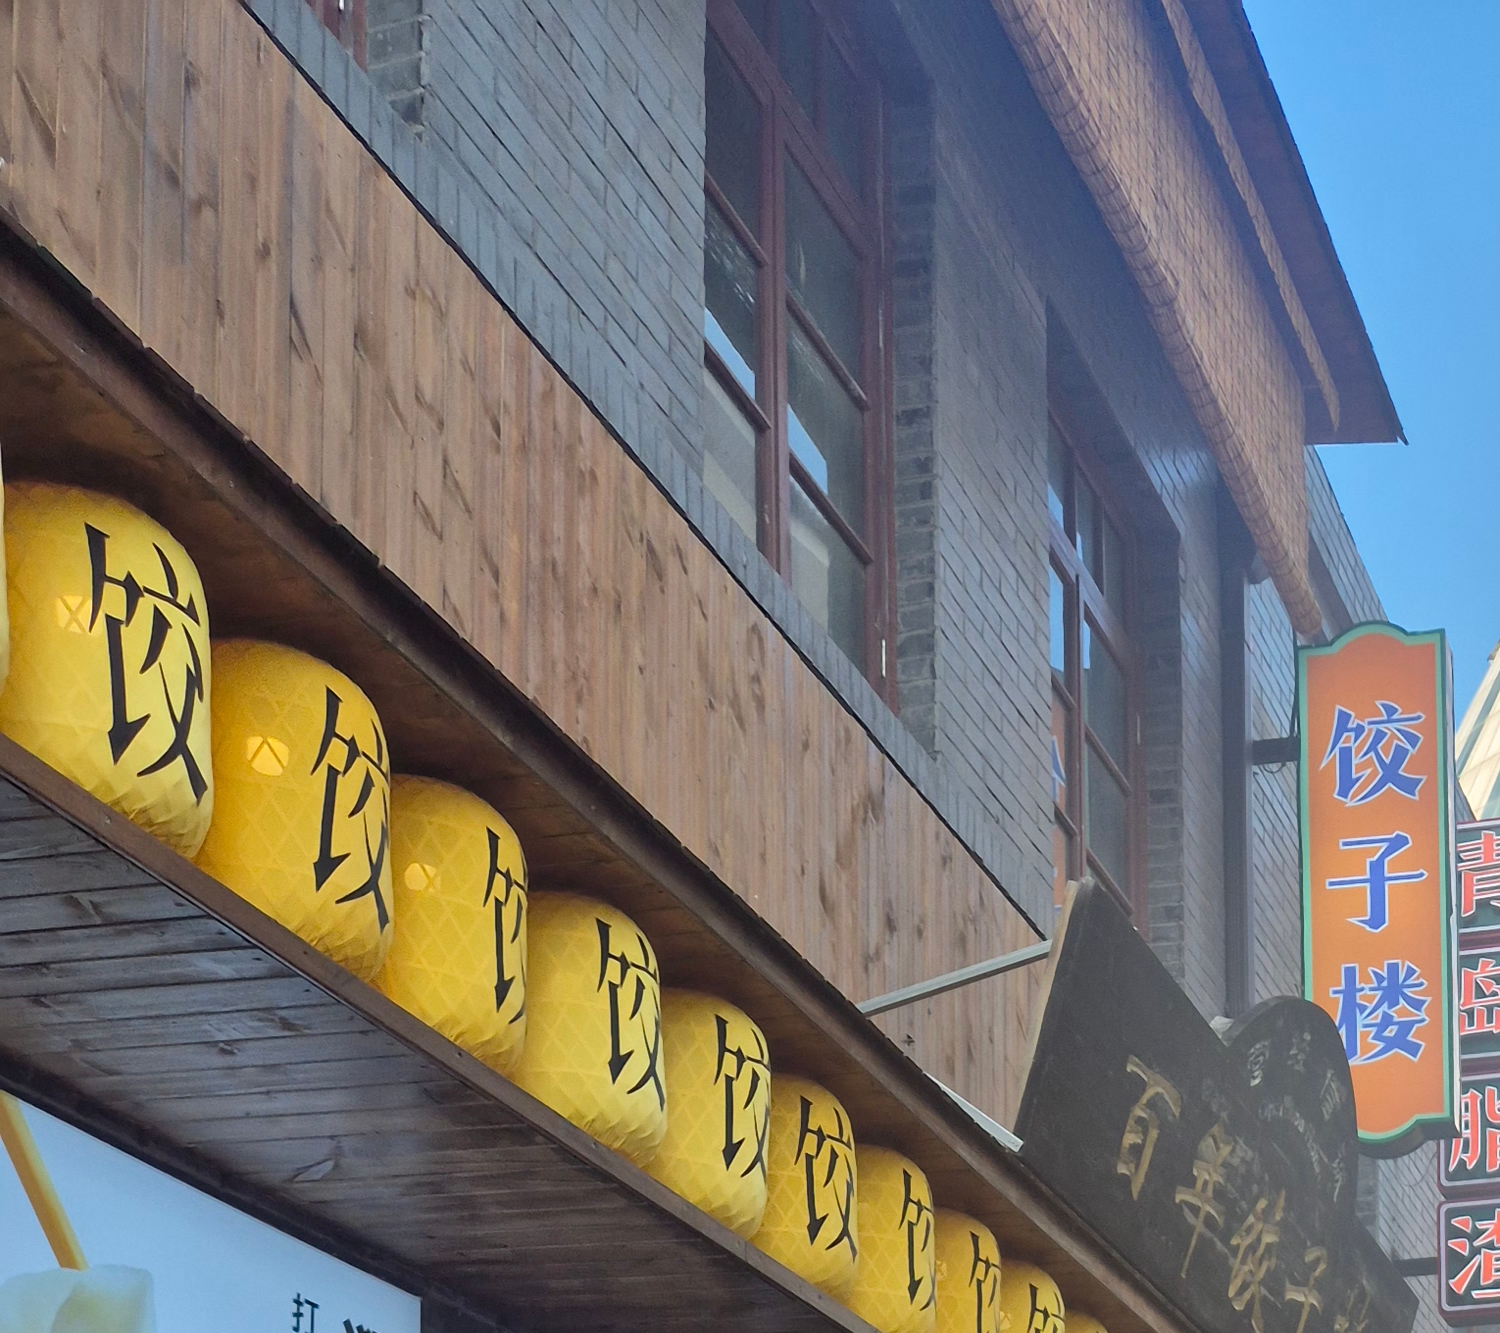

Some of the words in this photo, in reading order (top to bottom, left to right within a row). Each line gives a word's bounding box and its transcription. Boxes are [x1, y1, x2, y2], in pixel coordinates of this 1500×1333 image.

[84, 523, 208, 801] 饺
[311, 687, 390, 933] 饺
[1319, 701, 1432, 1066] 饺子楼
[596, 918, 665, 1107] 饺
[796, 1096, 857, 1262] 饺
